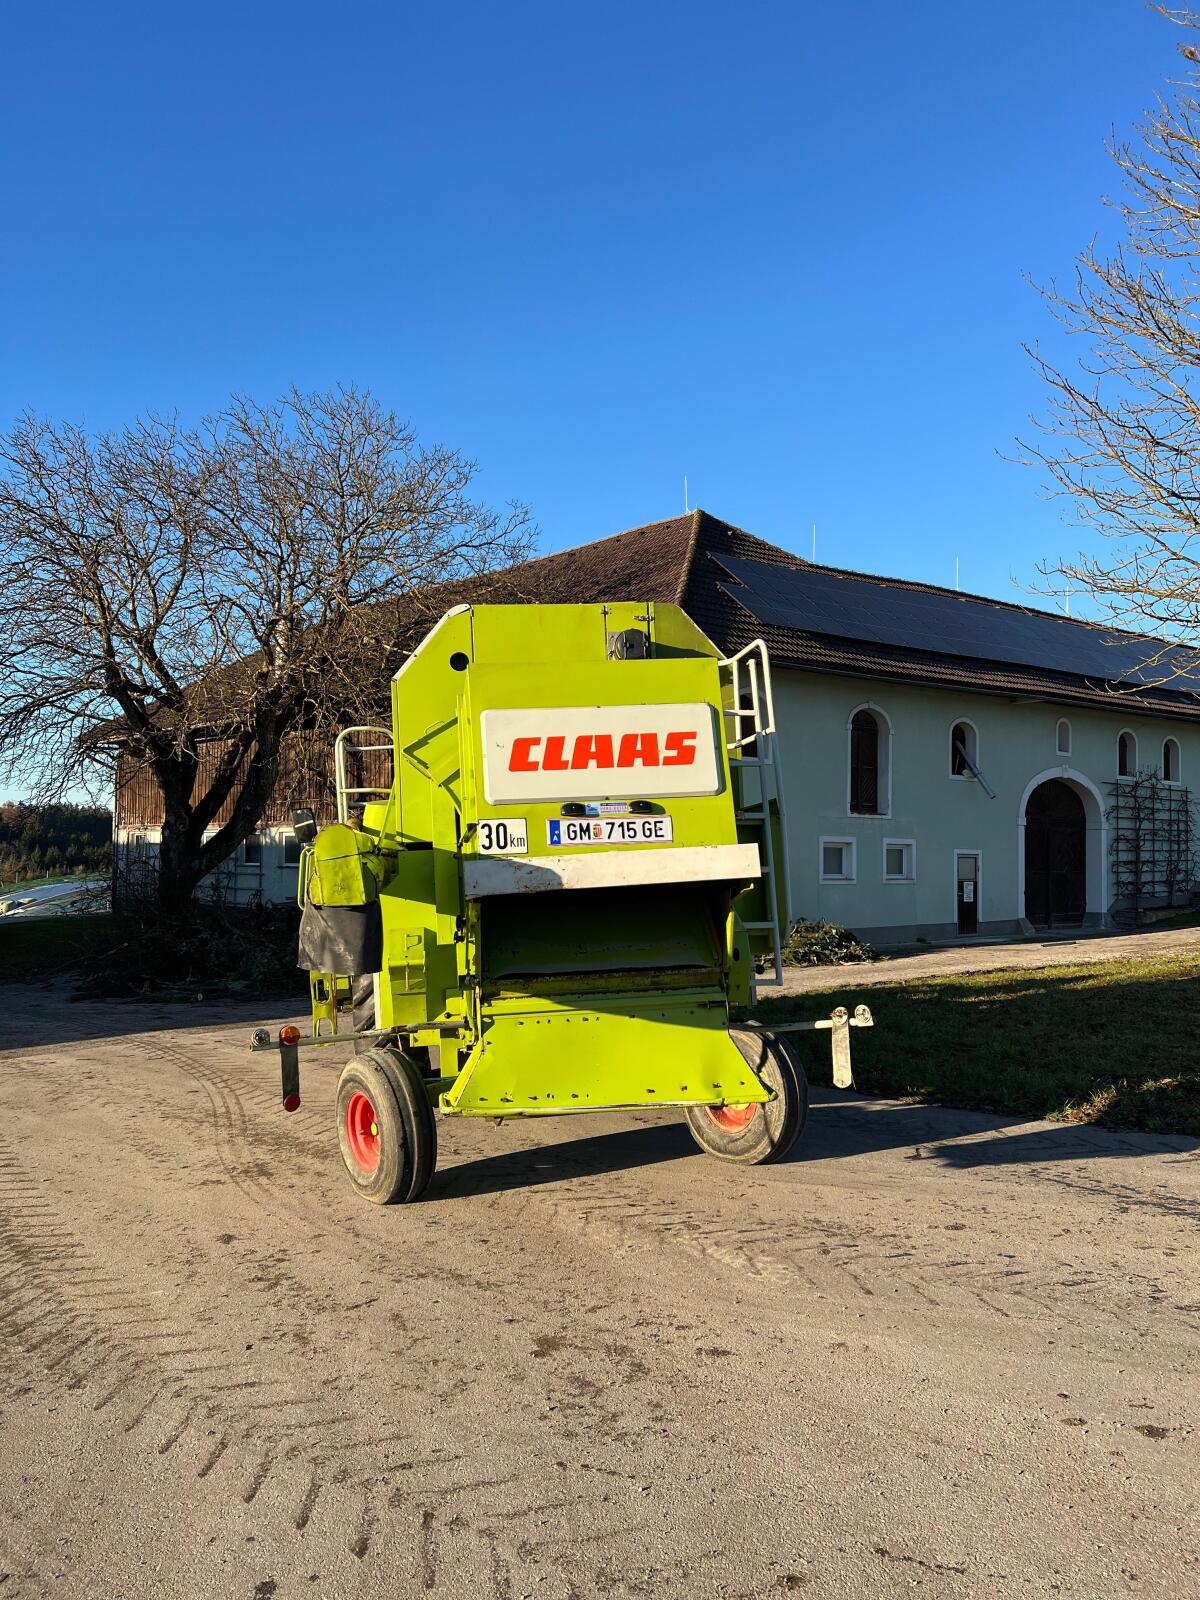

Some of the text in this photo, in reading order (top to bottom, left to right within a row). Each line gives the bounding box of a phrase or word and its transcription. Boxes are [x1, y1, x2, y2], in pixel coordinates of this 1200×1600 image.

[508, 731, 698, 772] CLAAS
[480, 822, 526, 850] 30 km
[566, 820, 665, 840] GM 715 GE
